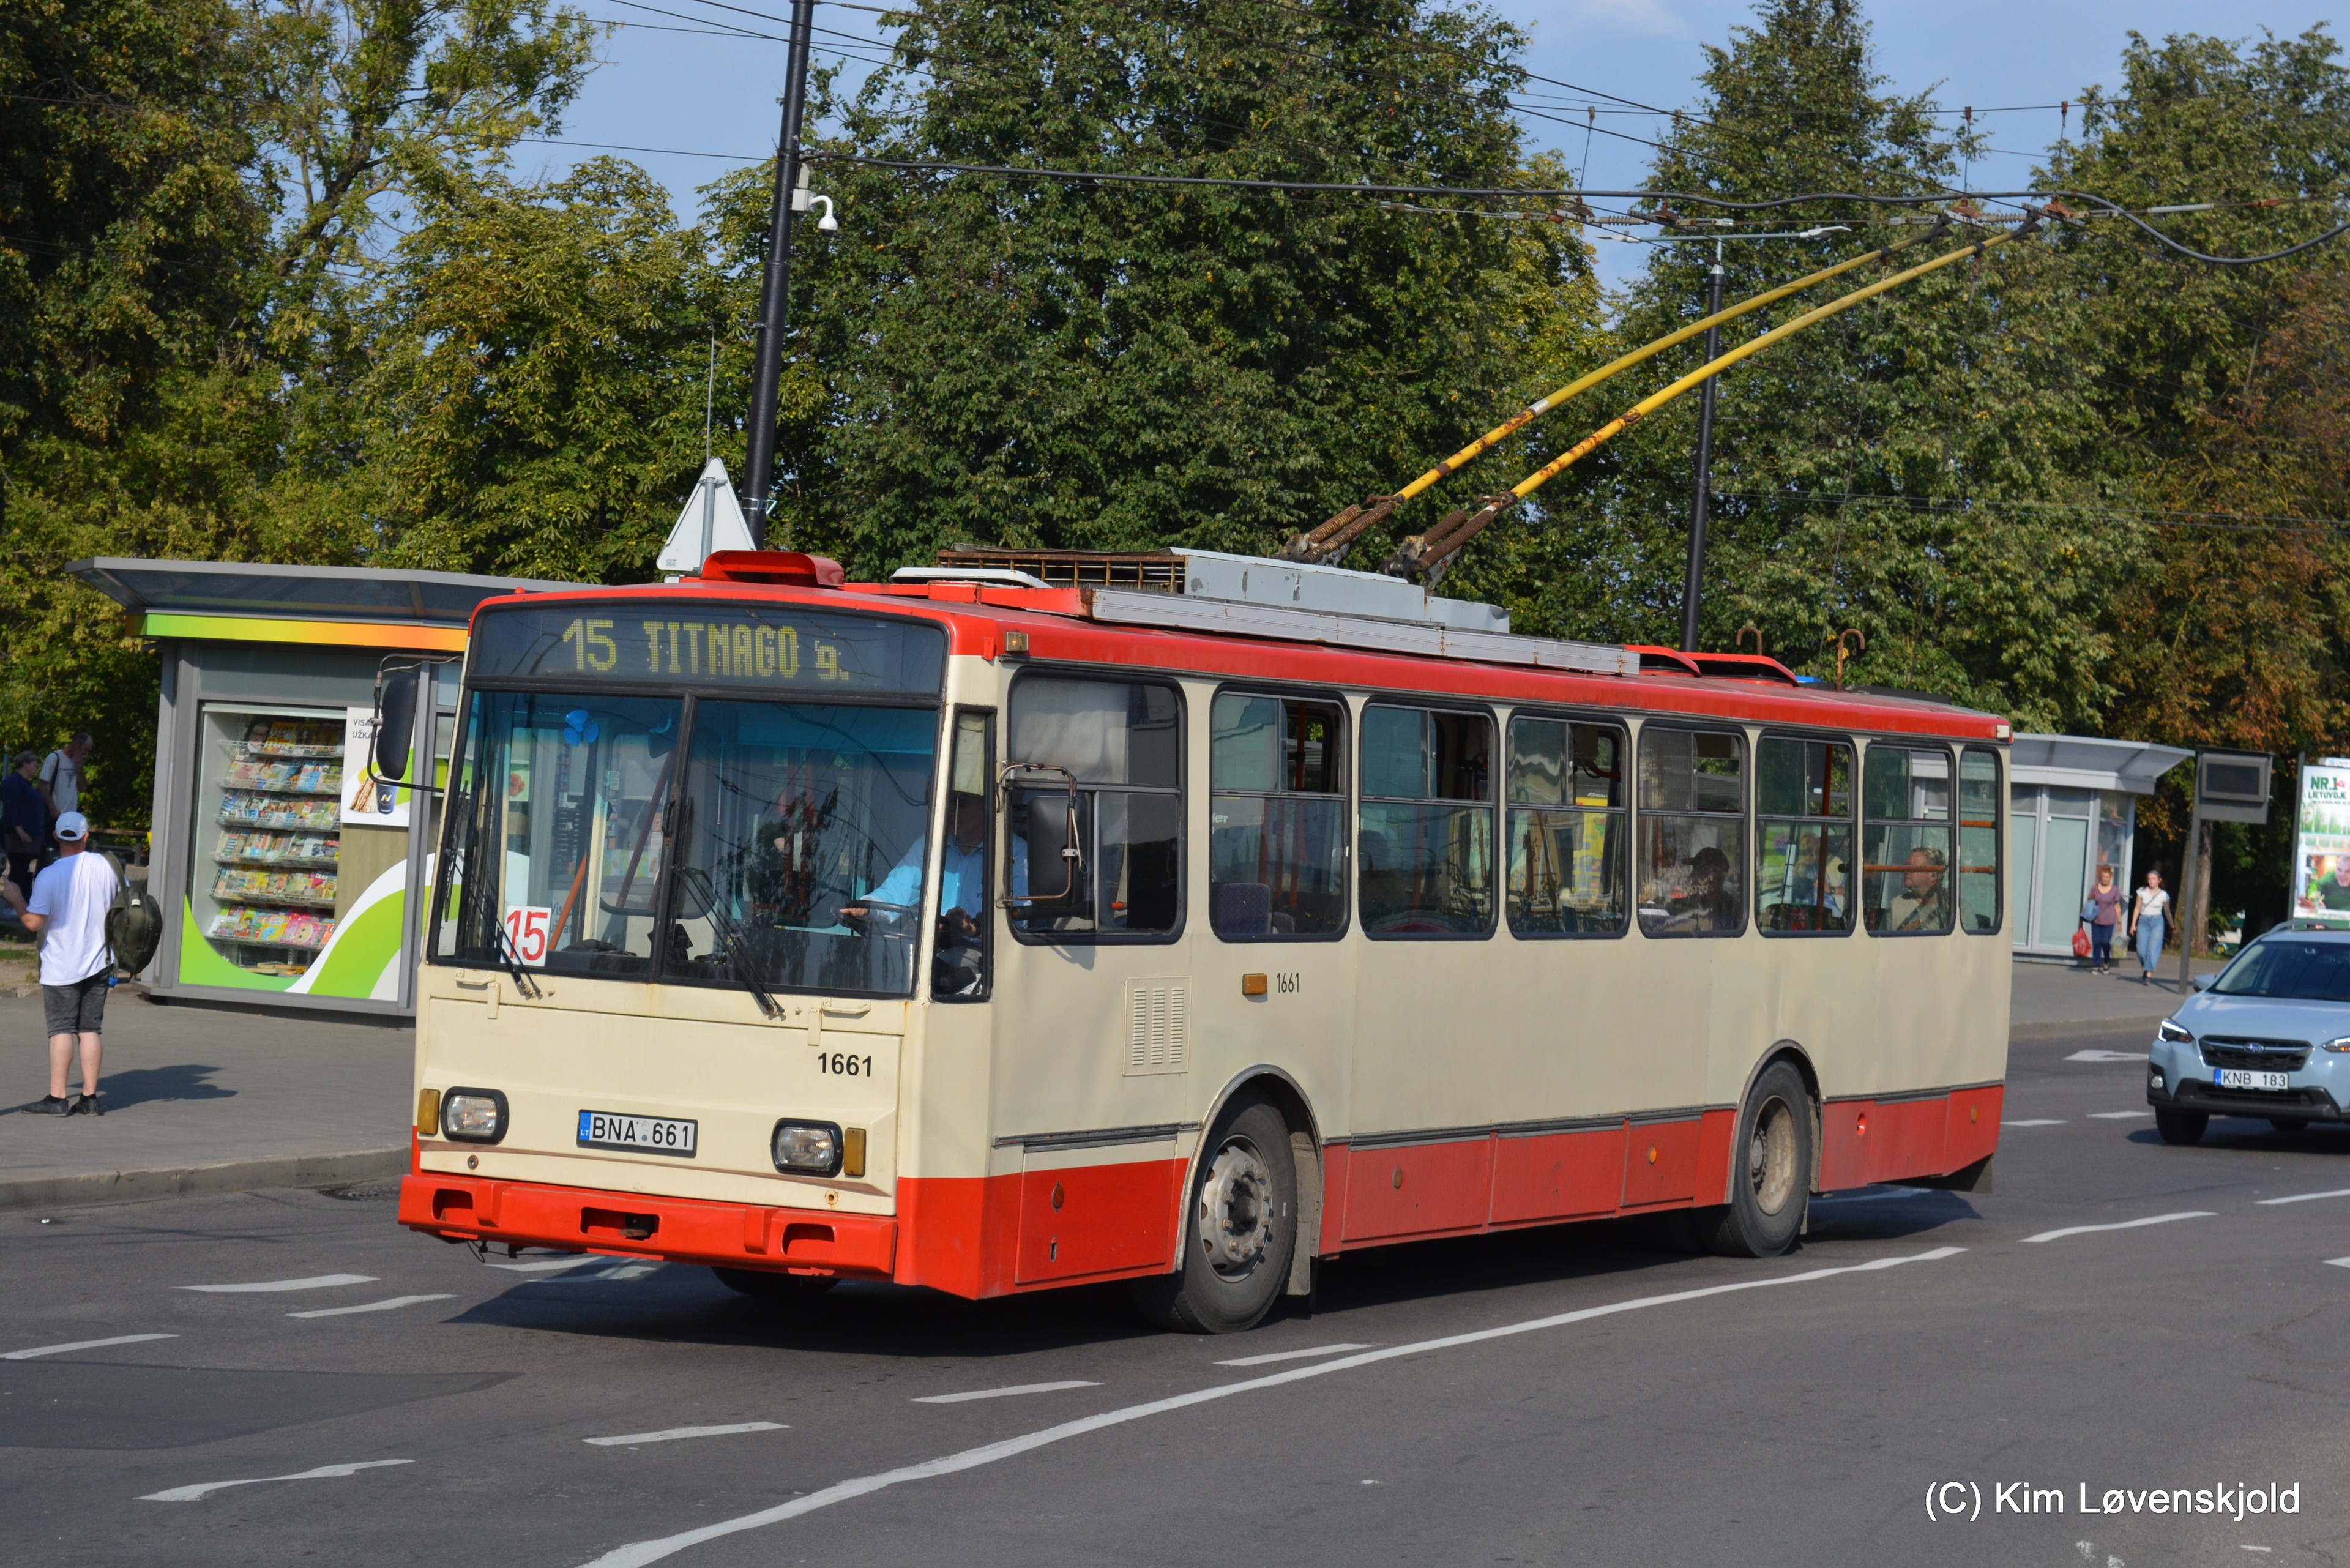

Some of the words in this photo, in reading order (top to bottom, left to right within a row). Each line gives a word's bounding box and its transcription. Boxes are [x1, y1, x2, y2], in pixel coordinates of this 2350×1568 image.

[562, 618, 617, 671] 15
[506, 910, 548, 961] 15
[1277, 973, 1299, 993] 1661
[818, 1052, 872, 1077] 1661
[2223, 1072, 2251, 1085] KNB
[2263, 1074, 2286, 1087] 183
[592, 1116, 636, 1142] BNA
[652, 1122, 688, 1147] 661
